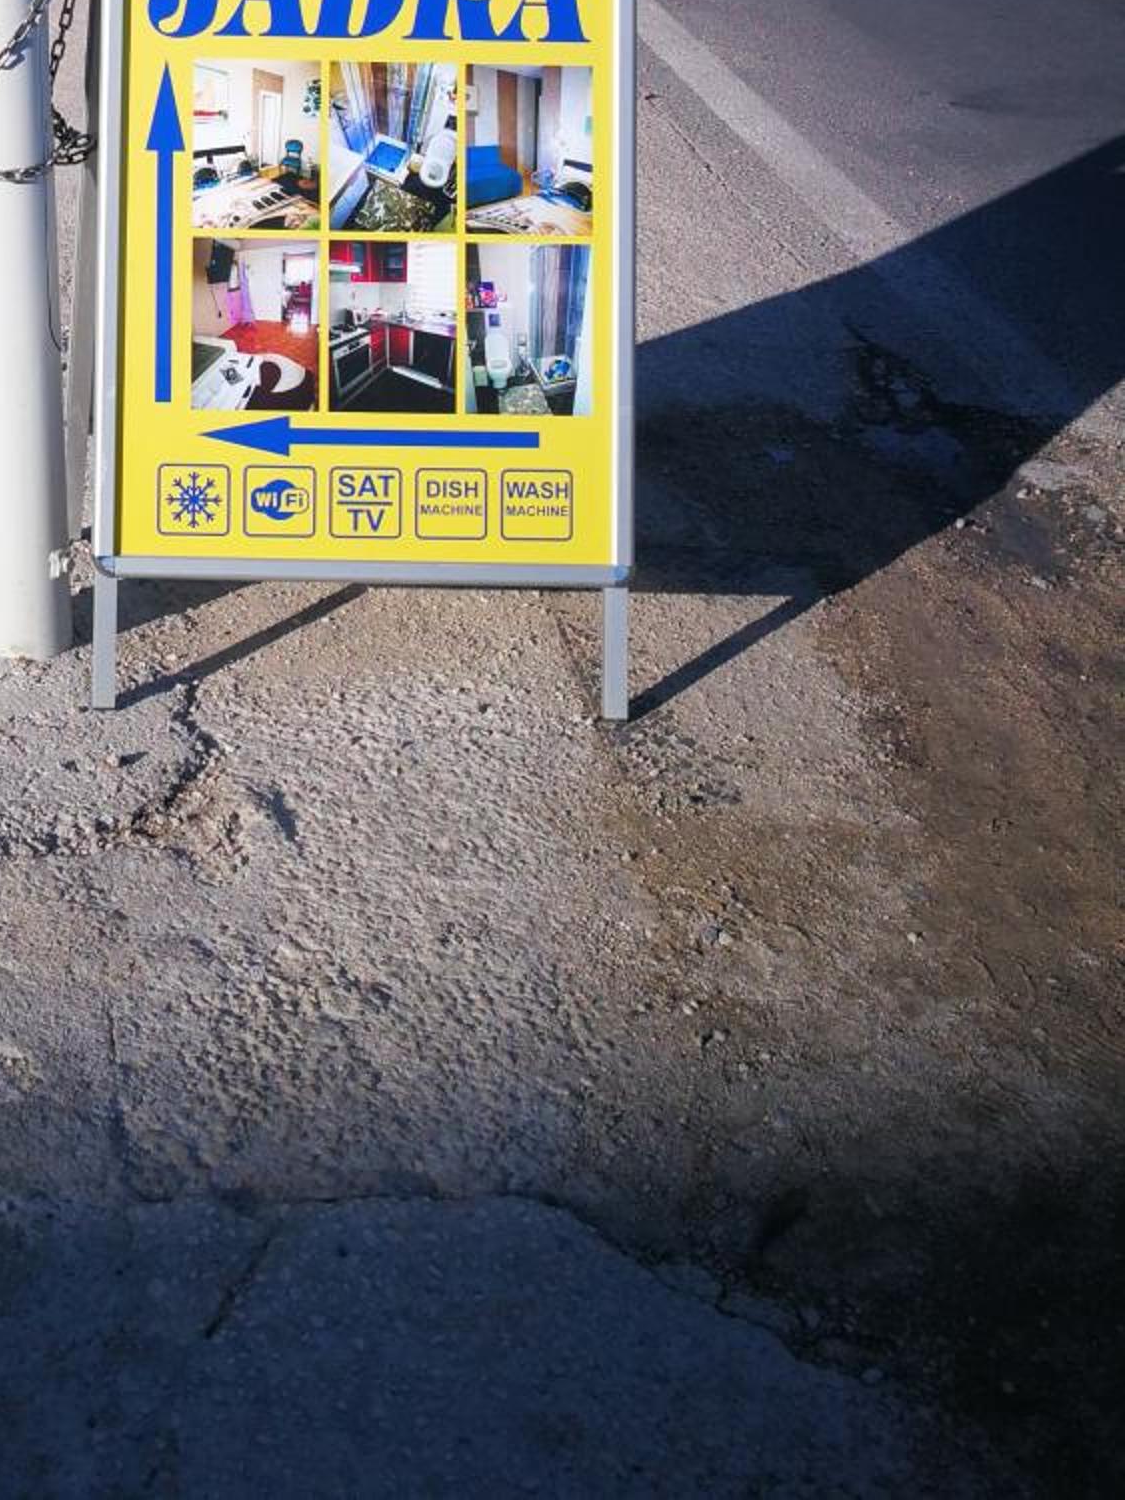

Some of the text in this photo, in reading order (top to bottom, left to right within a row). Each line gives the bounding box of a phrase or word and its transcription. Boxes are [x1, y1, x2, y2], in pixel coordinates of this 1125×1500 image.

[338, 474, 395, 498] SAT
[426, 480, 479, 499] DISH
[506, 481, 569, 499] WASH
[420, 504, 483, 517] MACHINE
[506, 504, 570, 517] MACHINE
[347, 508, 385, 532] TV
